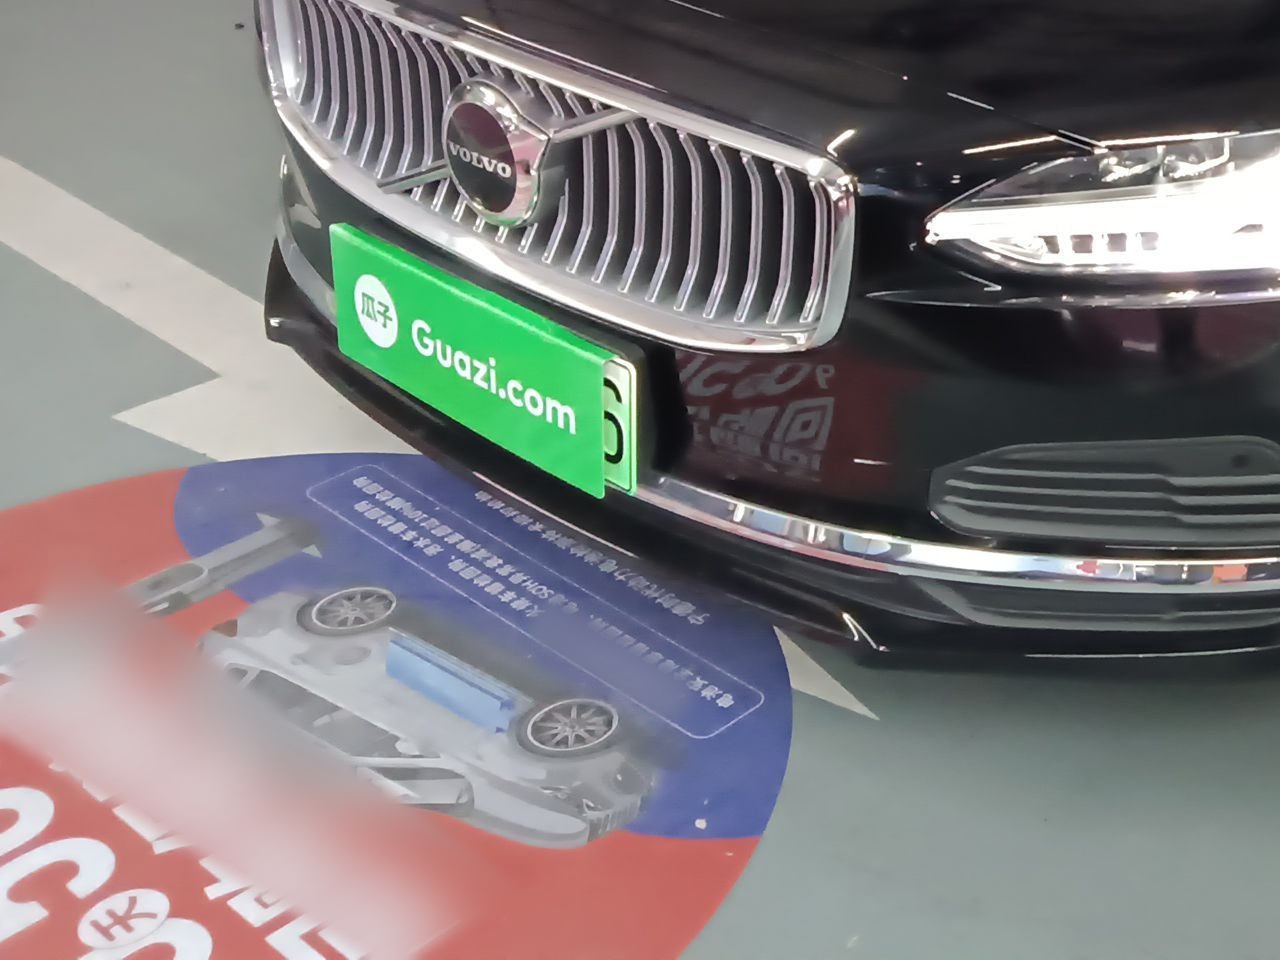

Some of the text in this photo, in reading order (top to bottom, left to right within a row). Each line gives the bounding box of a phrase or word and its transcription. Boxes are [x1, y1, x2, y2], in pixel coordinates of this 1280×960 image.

[447, 141, 513, 179] VOLVO
[360, 290, 393, 330] 瓜子
[410, 318, 577, 437] Guazi.com
